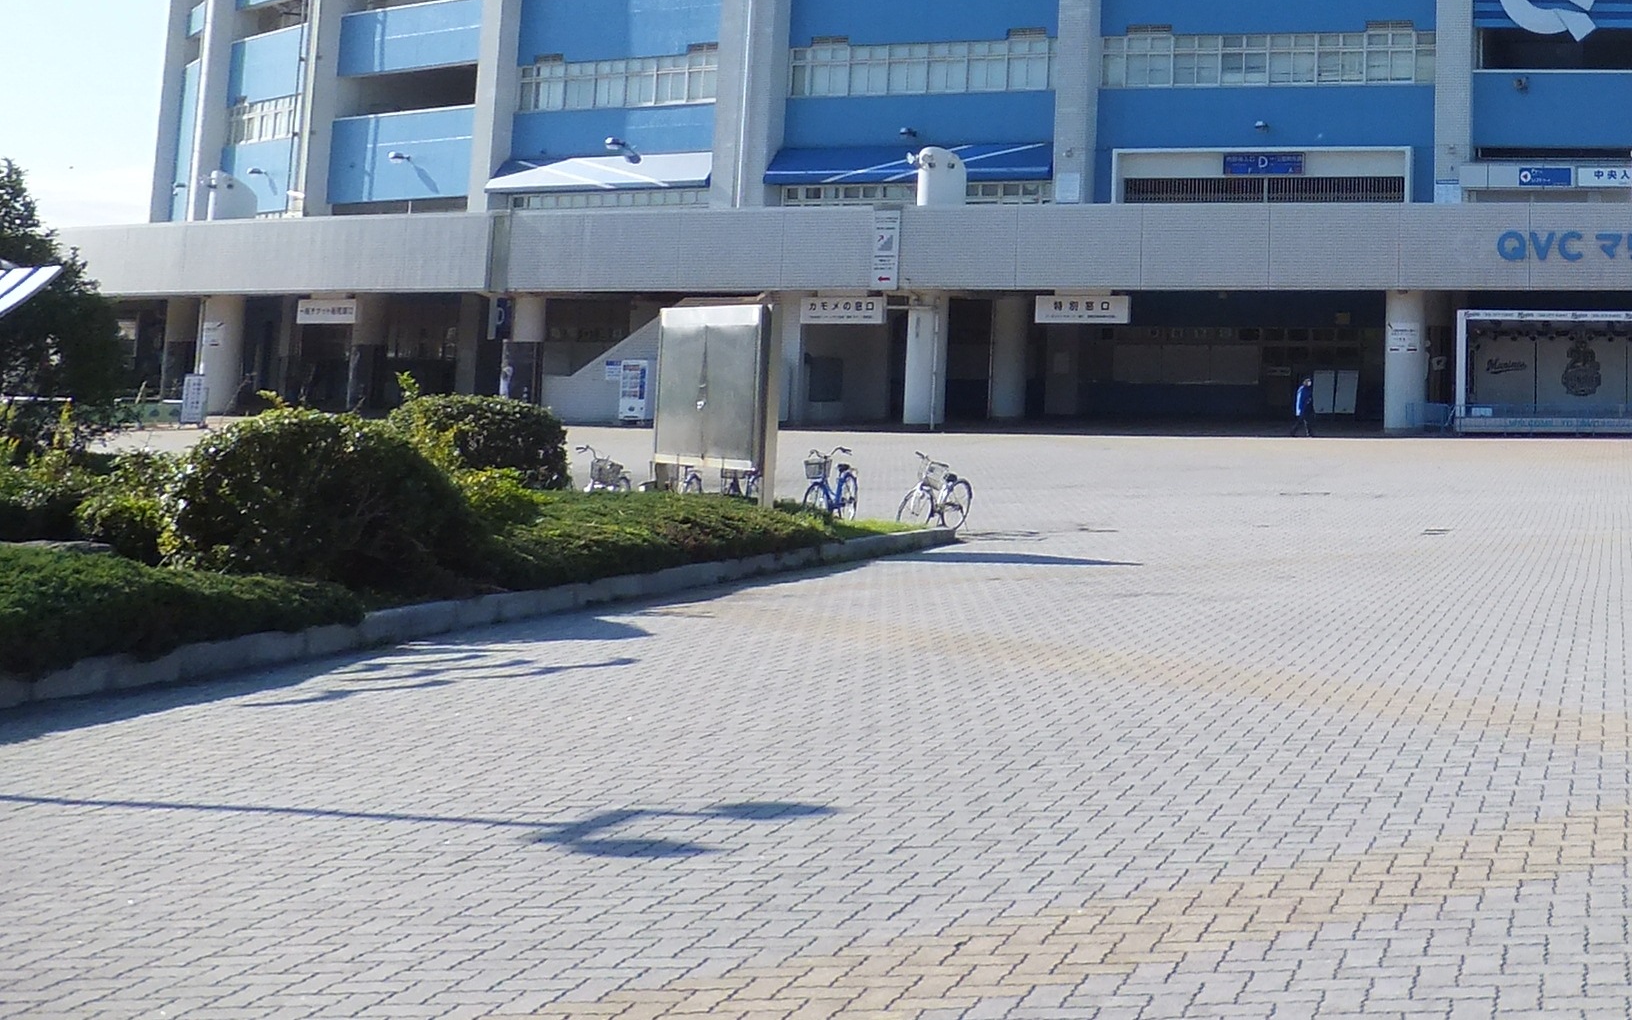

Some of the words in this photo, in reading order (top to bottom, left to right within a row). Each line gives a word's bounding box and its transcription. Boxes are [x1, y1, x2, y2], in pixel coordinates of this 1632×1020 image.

[1496, 231, 1583, 262] QVC
[808, 301, 875, 311] カモメの窓口
[1053, 300, 1110, 311] 特別窓口
